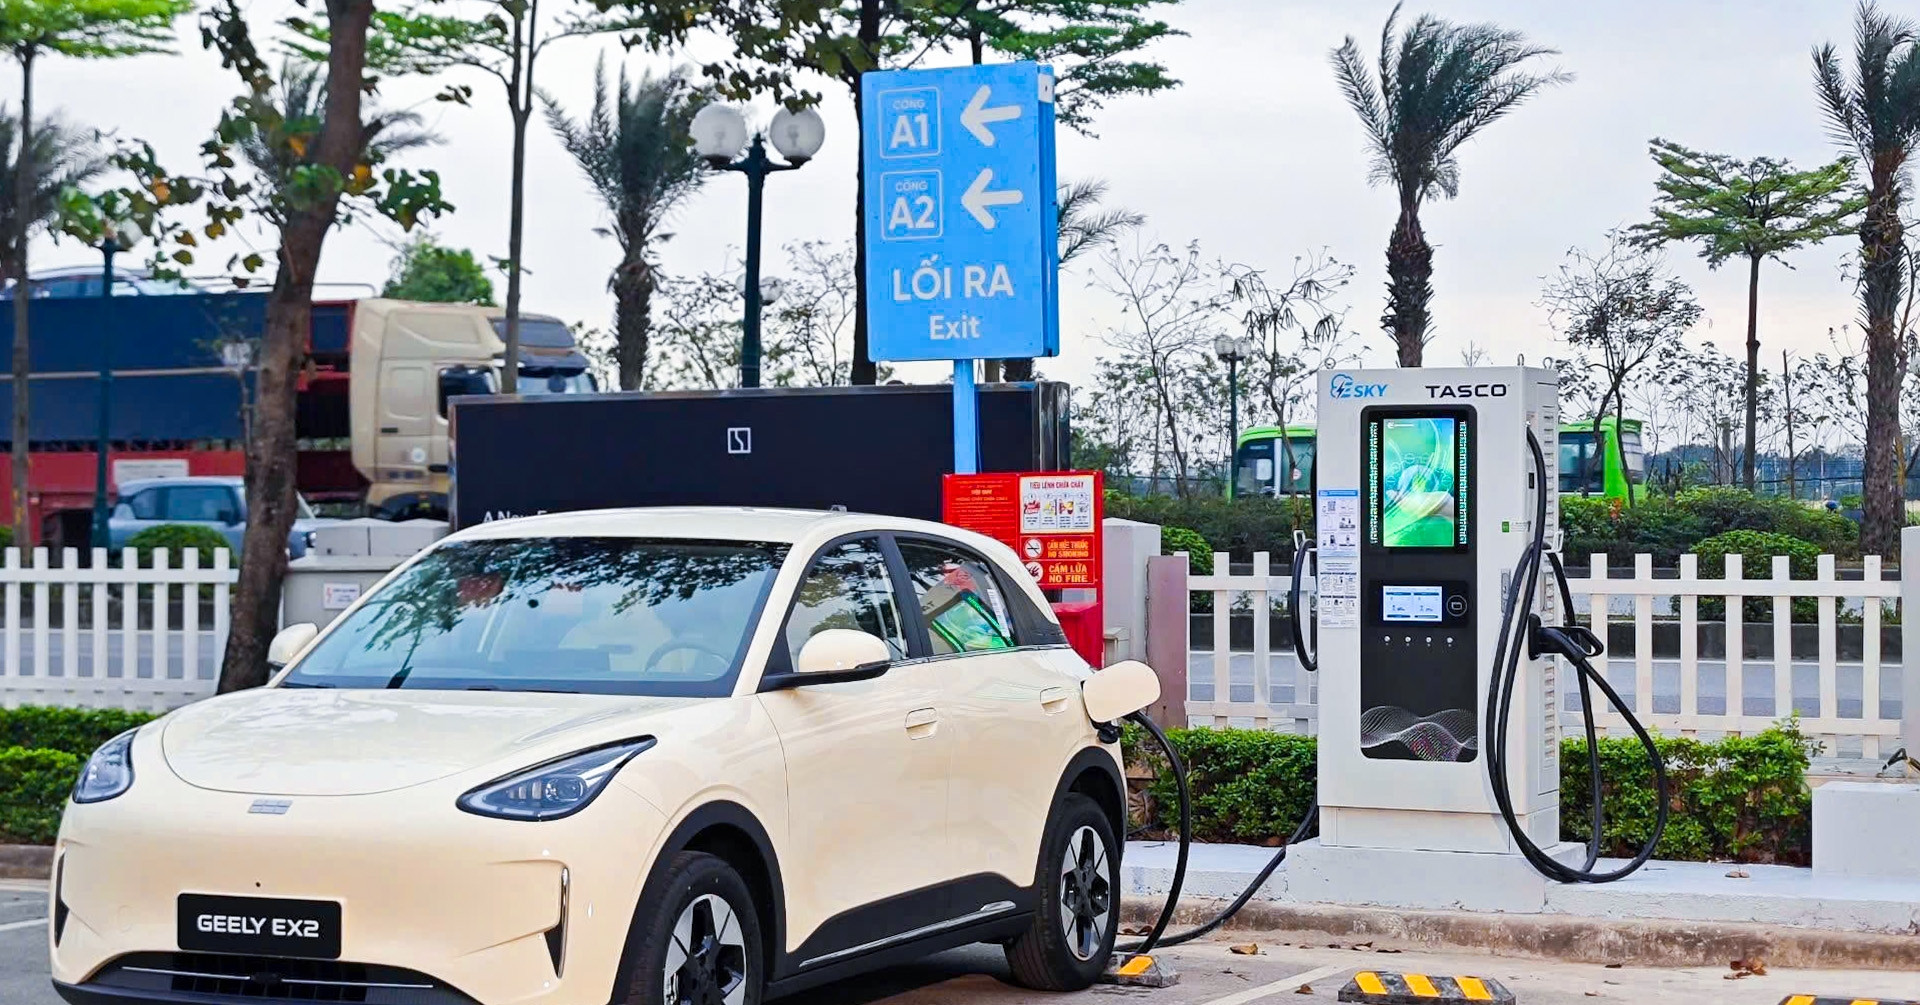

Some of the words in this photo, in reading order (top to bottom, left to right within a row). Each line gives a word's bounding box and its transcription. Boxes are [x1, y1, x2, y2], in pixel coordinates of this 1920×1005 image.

[890, 113, 929, 149] A1
[888, 195, 936, 230] A2
[893, 254, 952, 301] LỐI
[964, 264, 1015, 298] RA
[929, 314, 981, 340] Exit
[1425, 384, 1507, 398] TASCO
[1049, 562, 1068, 573] CẤM
[1049, 574, 1063, 583] NO
[1065, 574, 1089, 583] FIRE
[197, 914, 267, 934] GEELY
[272, 918, 319, 938] EX2
